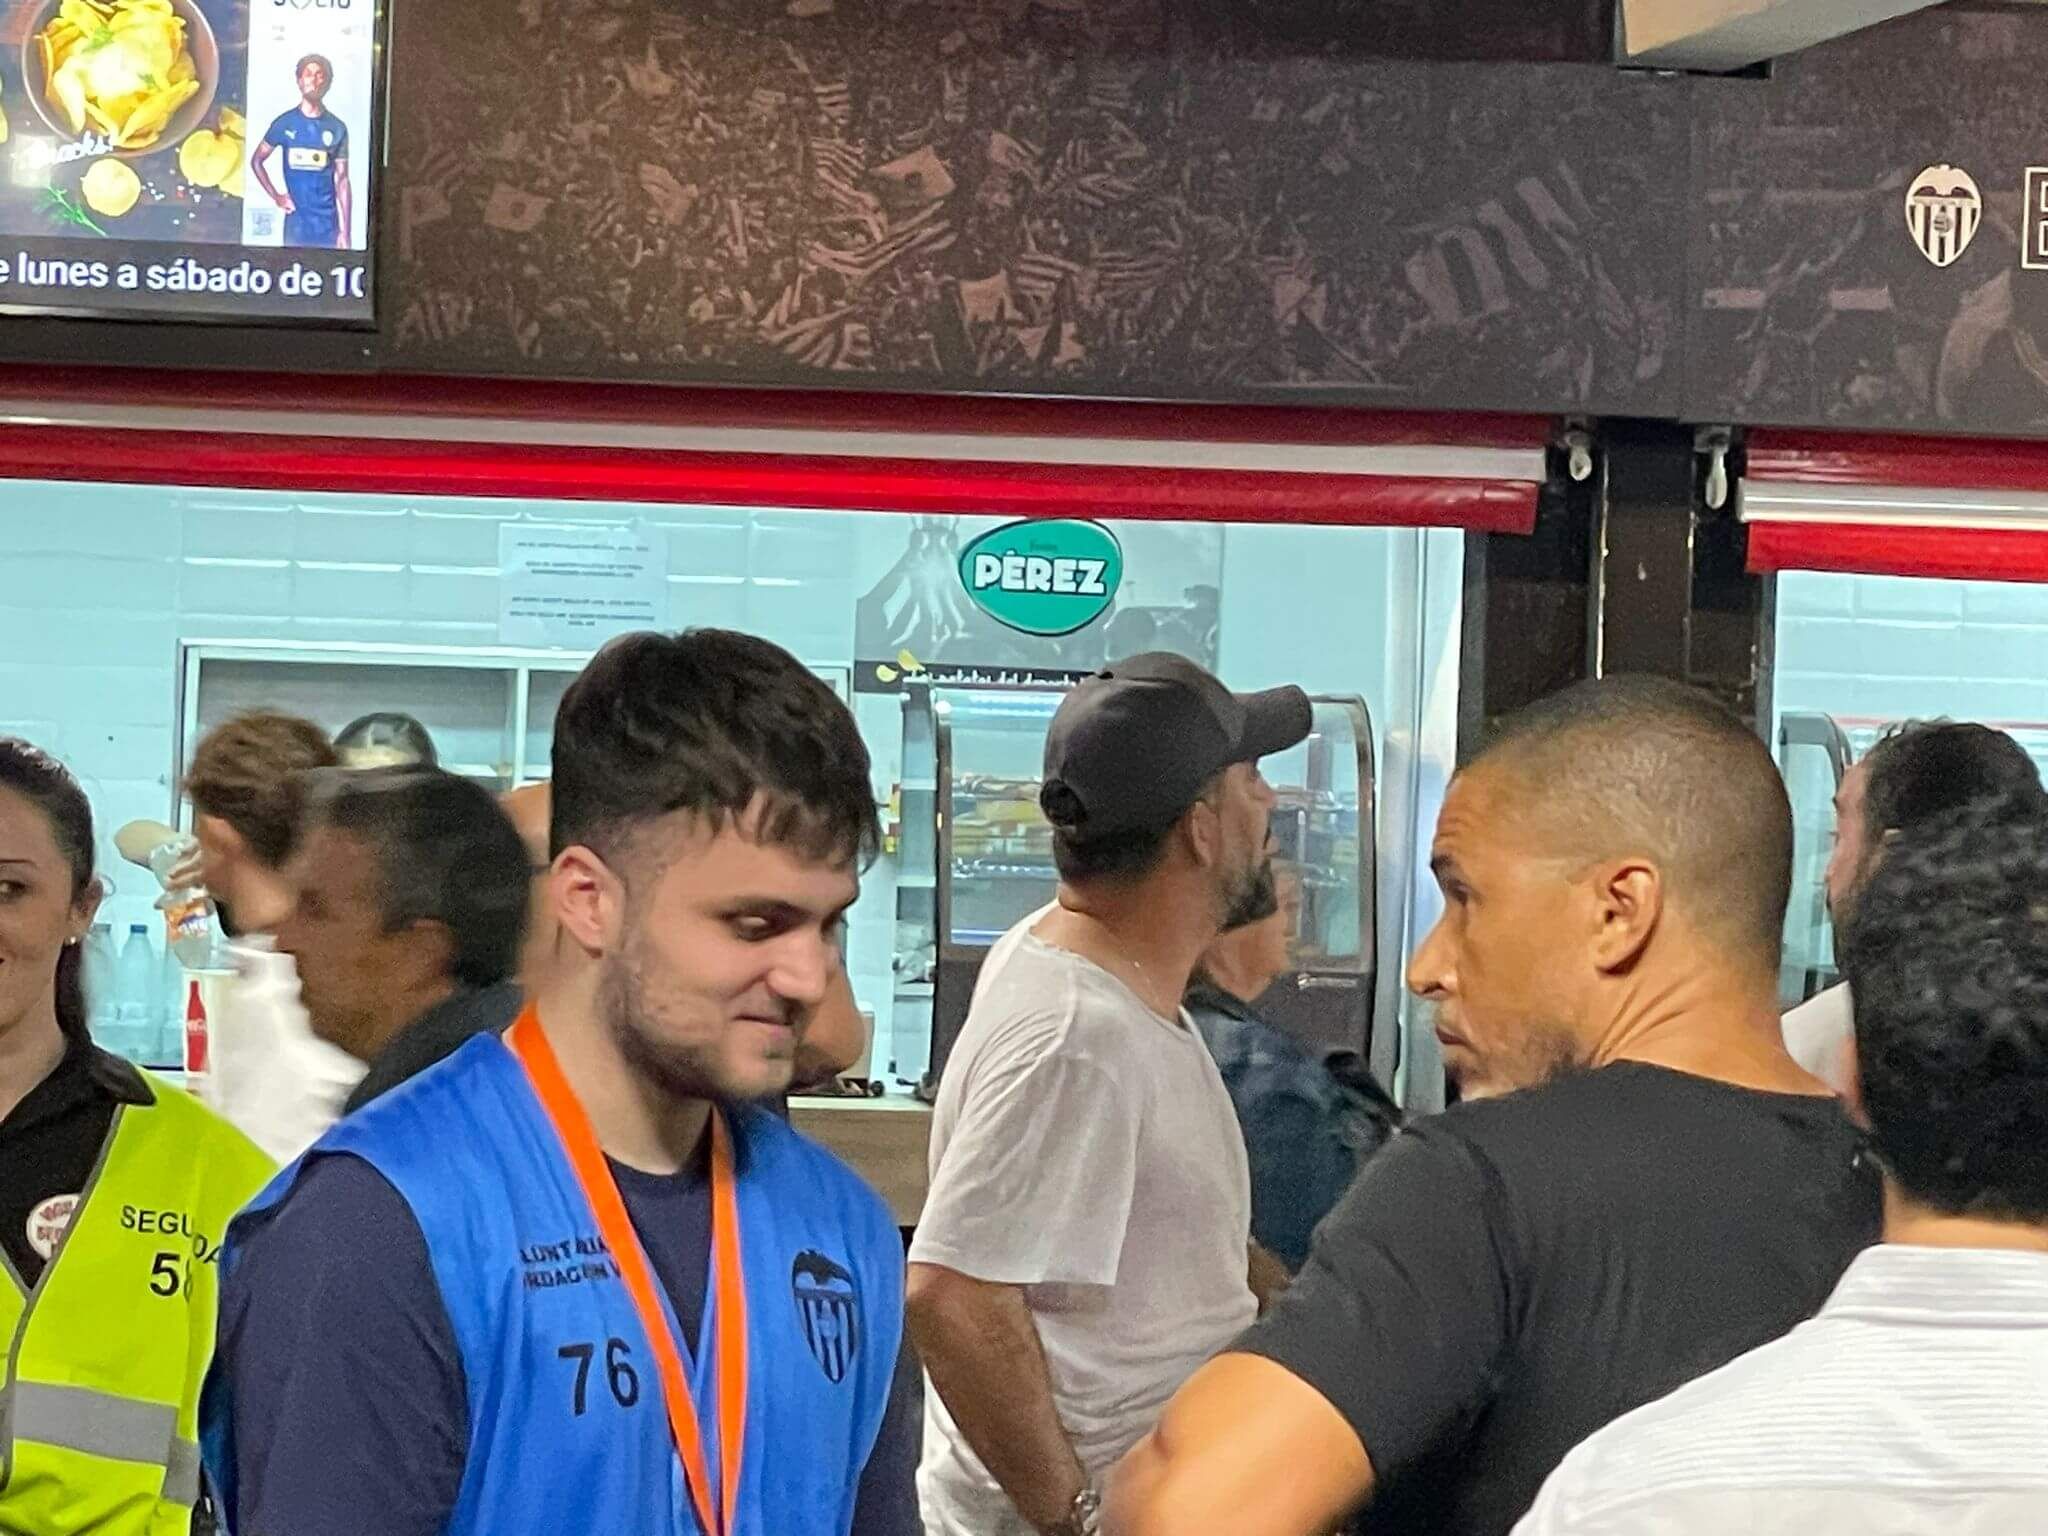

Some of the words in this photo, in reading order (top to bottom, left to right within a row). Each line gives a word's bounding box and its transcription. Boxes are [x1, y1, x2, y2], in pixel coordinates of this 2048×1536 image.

[18, 251, 109, 288] lunes
[117, 263, 139, 289] a
[146, 258, 272, 294] sábado
[279, 263, 323, 297] de
[974, 550, 1107, 596] PÉREZ
[558, 1338, 640, 1417] 76
